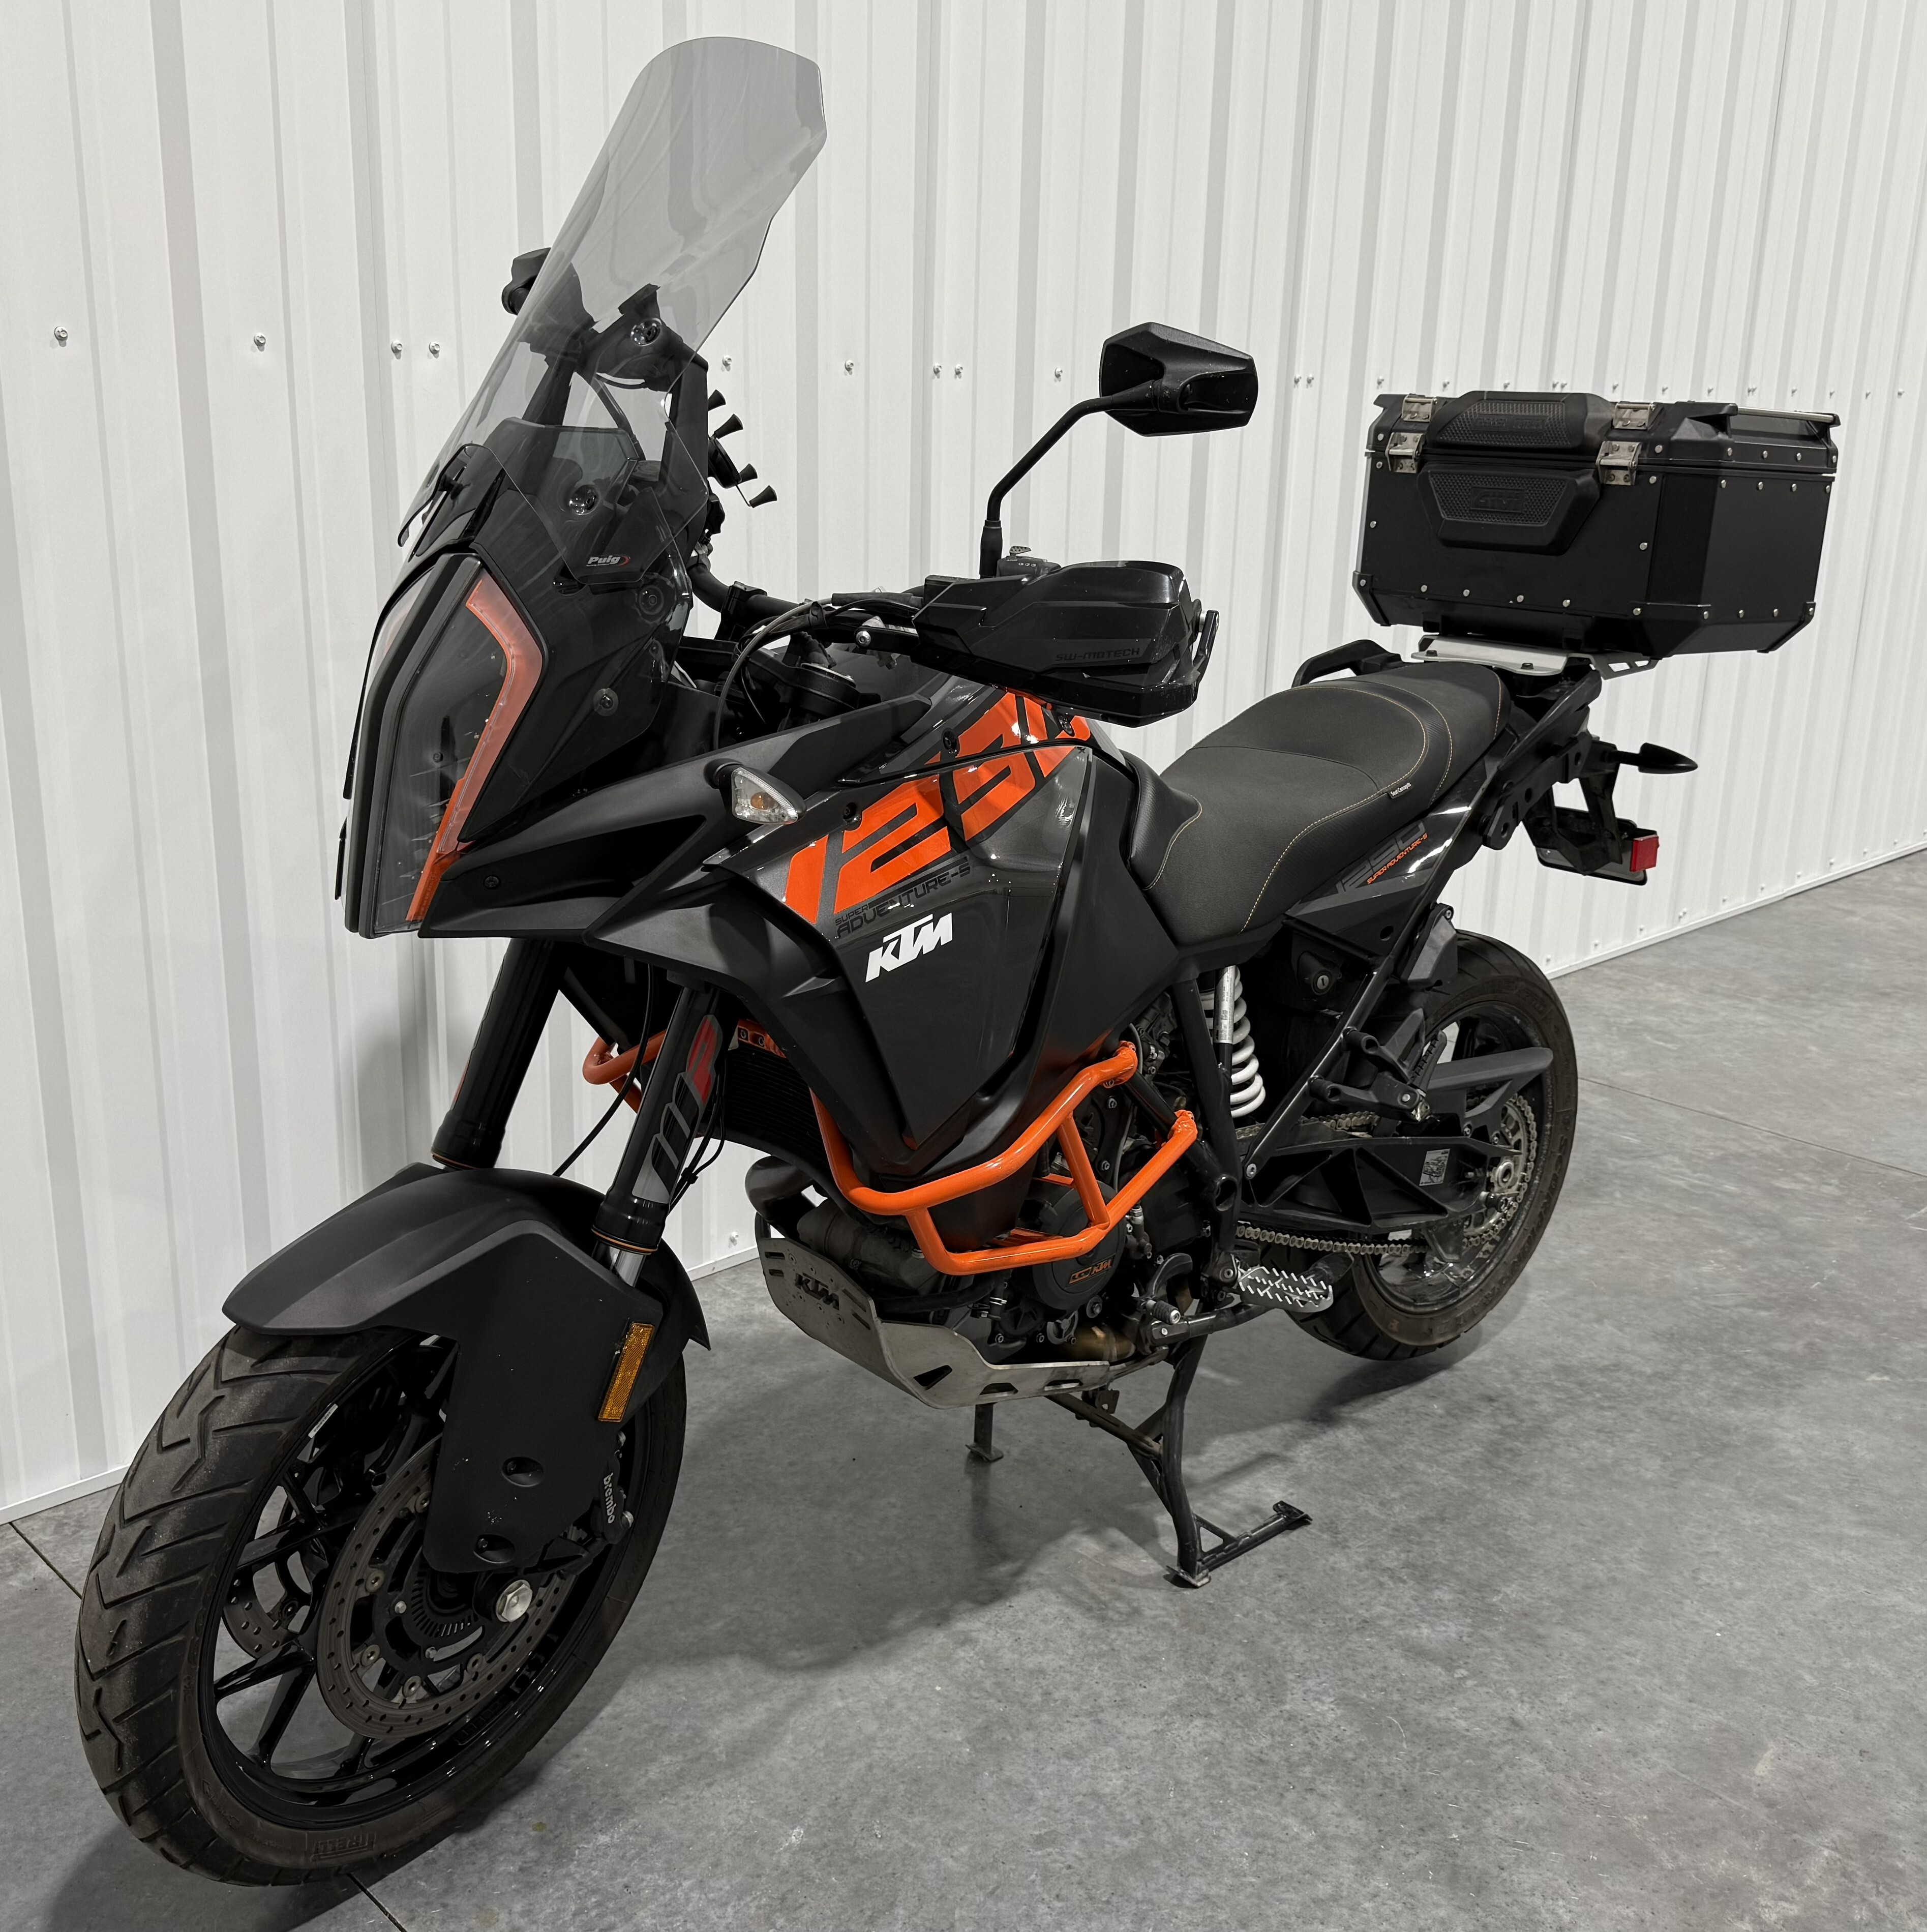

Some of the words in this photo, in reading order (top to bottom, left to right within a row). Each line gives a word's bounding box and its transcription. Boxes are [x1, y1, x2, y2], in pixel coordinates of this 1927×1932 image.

[587, 555, 621, 566] Puig
[1055, 648, 1140, 661] SW-MOTECH
[1367, 866, 1388, 885] SUPER
[835, 903, 869, 926] SUPER
[836, 863, 971, 938] ADVENTURE-S
[865, 912, 953, 983] KTM
[794, 1272, 840, 1311] KTM
[603, 1472, 617, 1524] brembo
